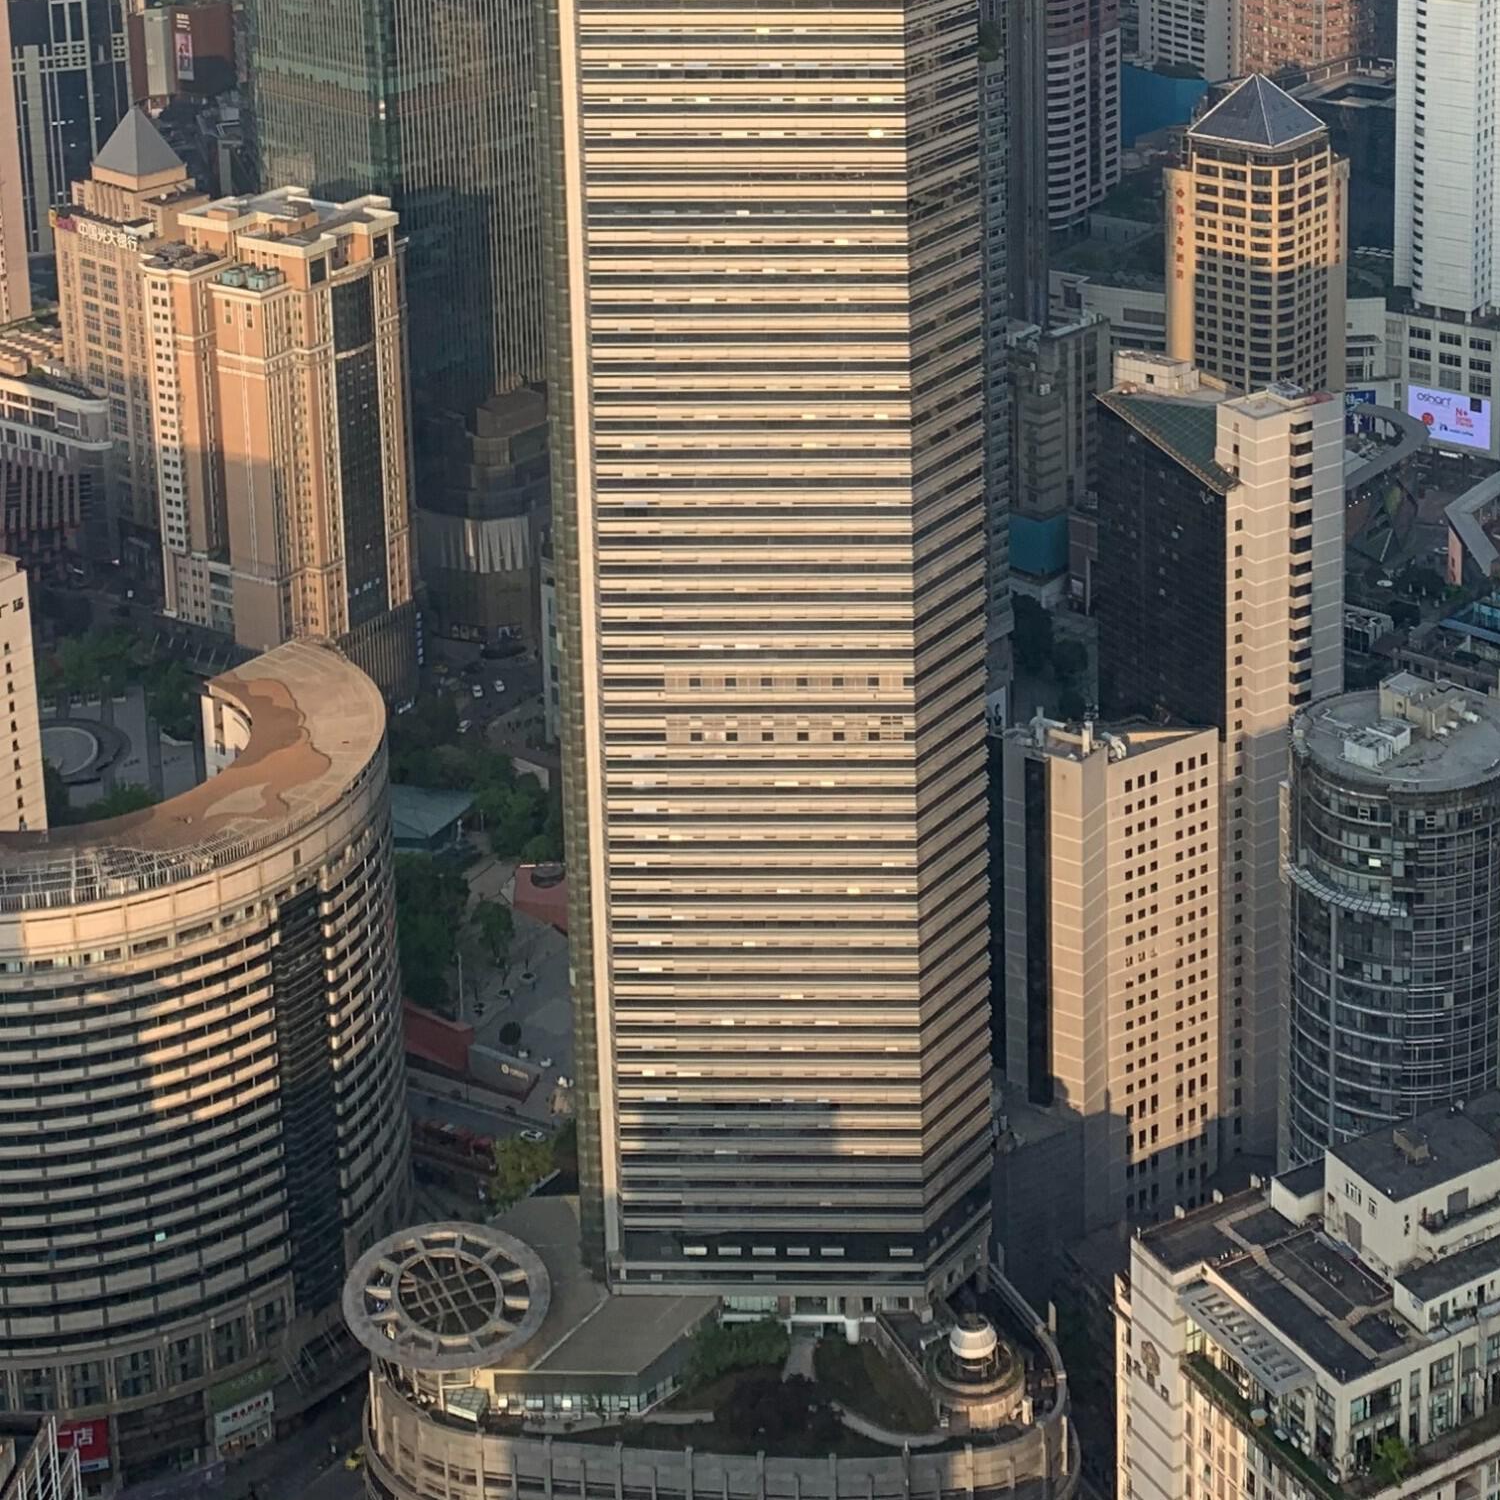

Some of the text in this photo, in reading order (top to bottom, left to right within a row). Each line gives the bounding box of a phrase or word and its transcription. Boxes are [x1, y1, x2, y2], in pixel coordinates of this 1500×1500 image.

[79, 222, 137, 252] 中国光大银行
